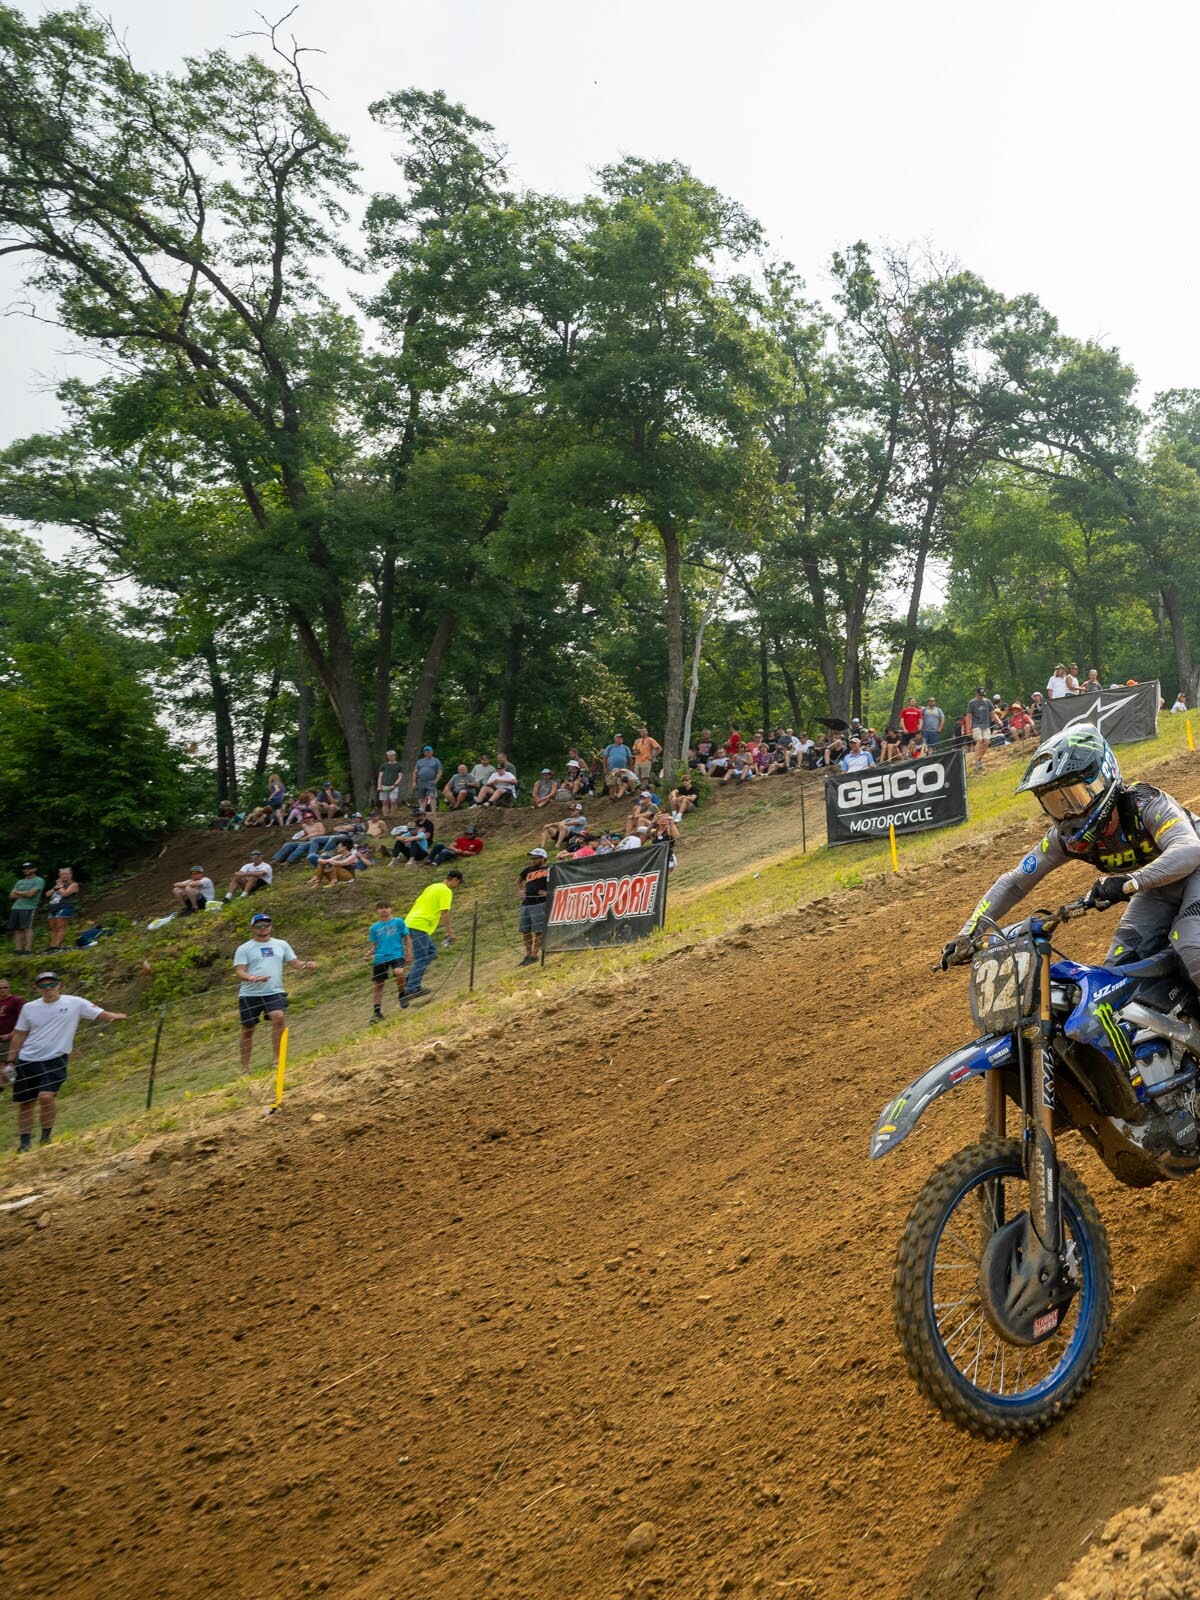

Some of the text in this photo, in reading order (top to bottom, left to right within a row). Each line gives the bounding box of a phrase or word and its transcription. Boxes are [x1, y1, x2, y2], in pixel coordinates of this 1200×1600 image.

[837, 763, 945, 809] GEICO
[850, 807, 933, 833] MOTORCYCLE
[976, 952, 1031, 1017] 32
